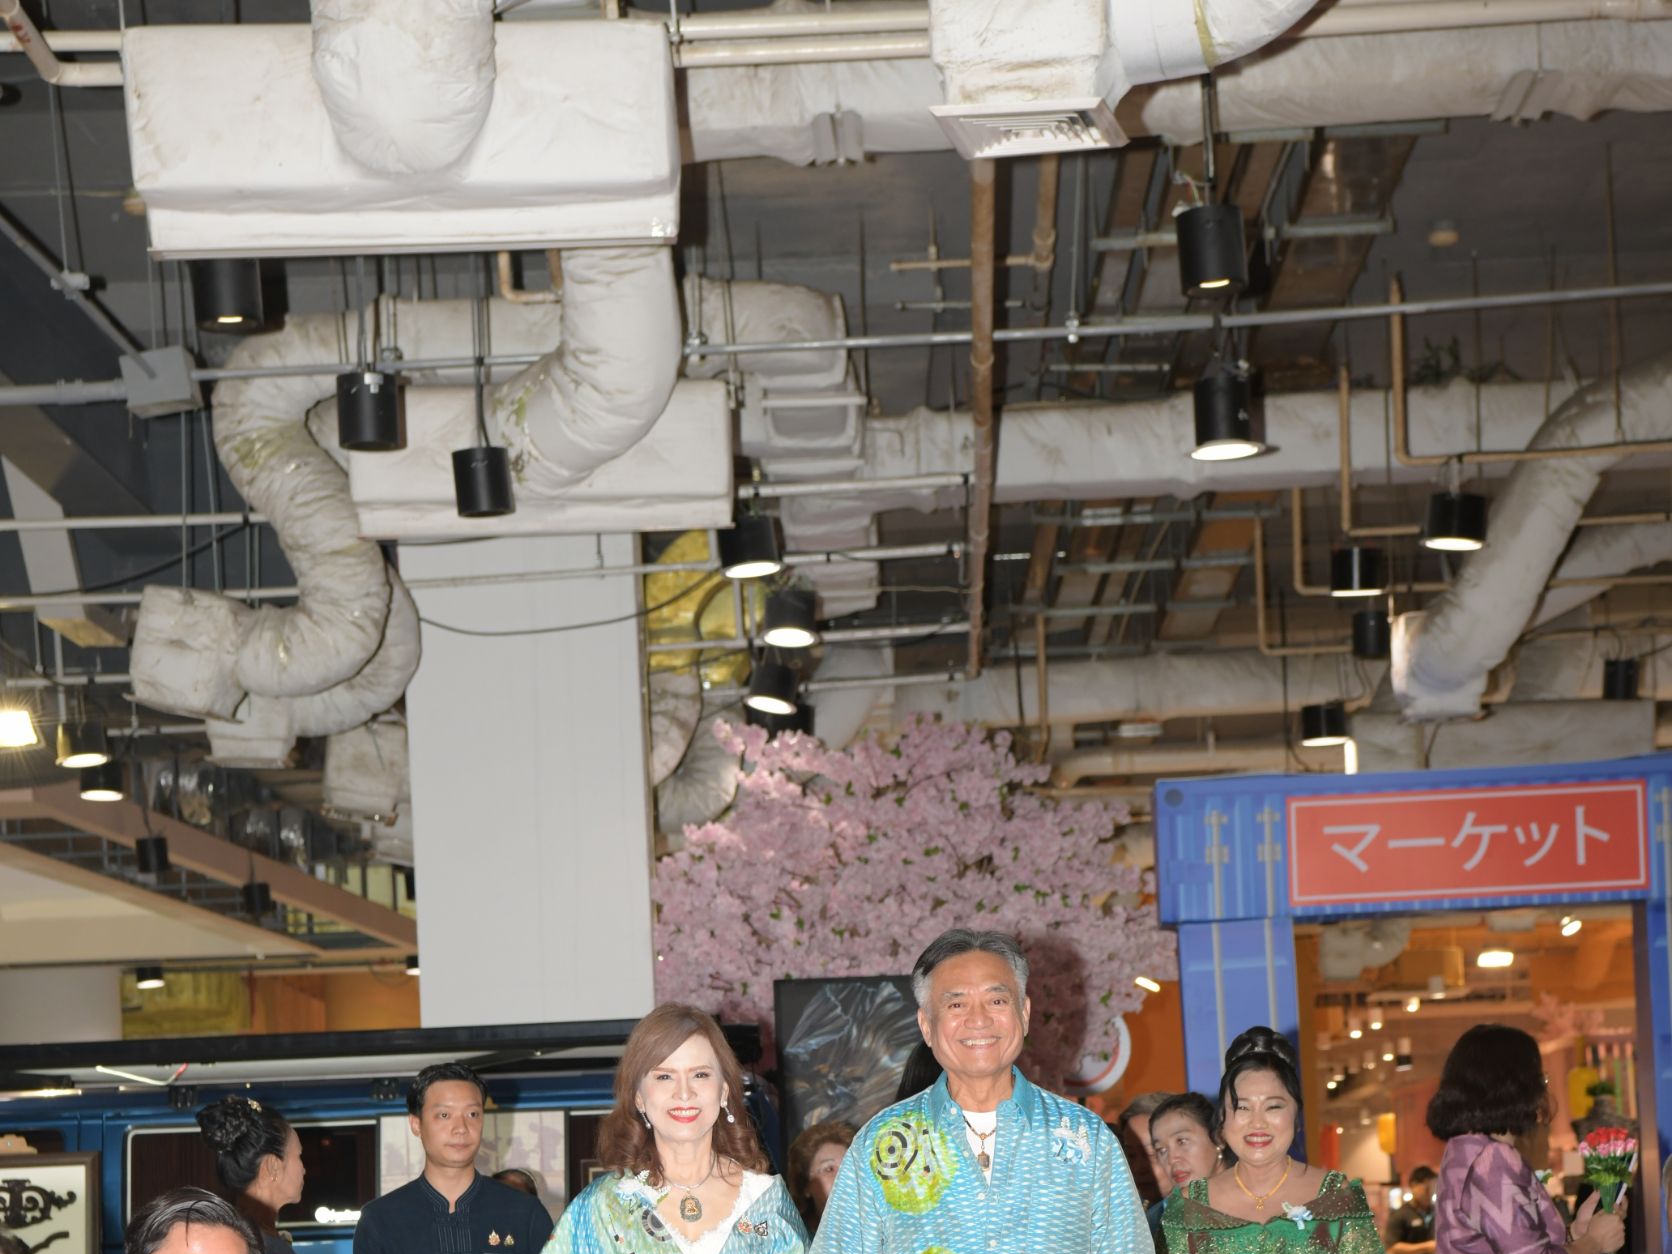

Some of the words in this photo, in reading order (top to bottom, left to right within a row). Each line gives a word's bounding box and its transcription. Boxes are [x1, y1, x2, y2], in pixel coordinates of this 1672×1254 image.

[1323, 805, 1610, 873] マーケット
